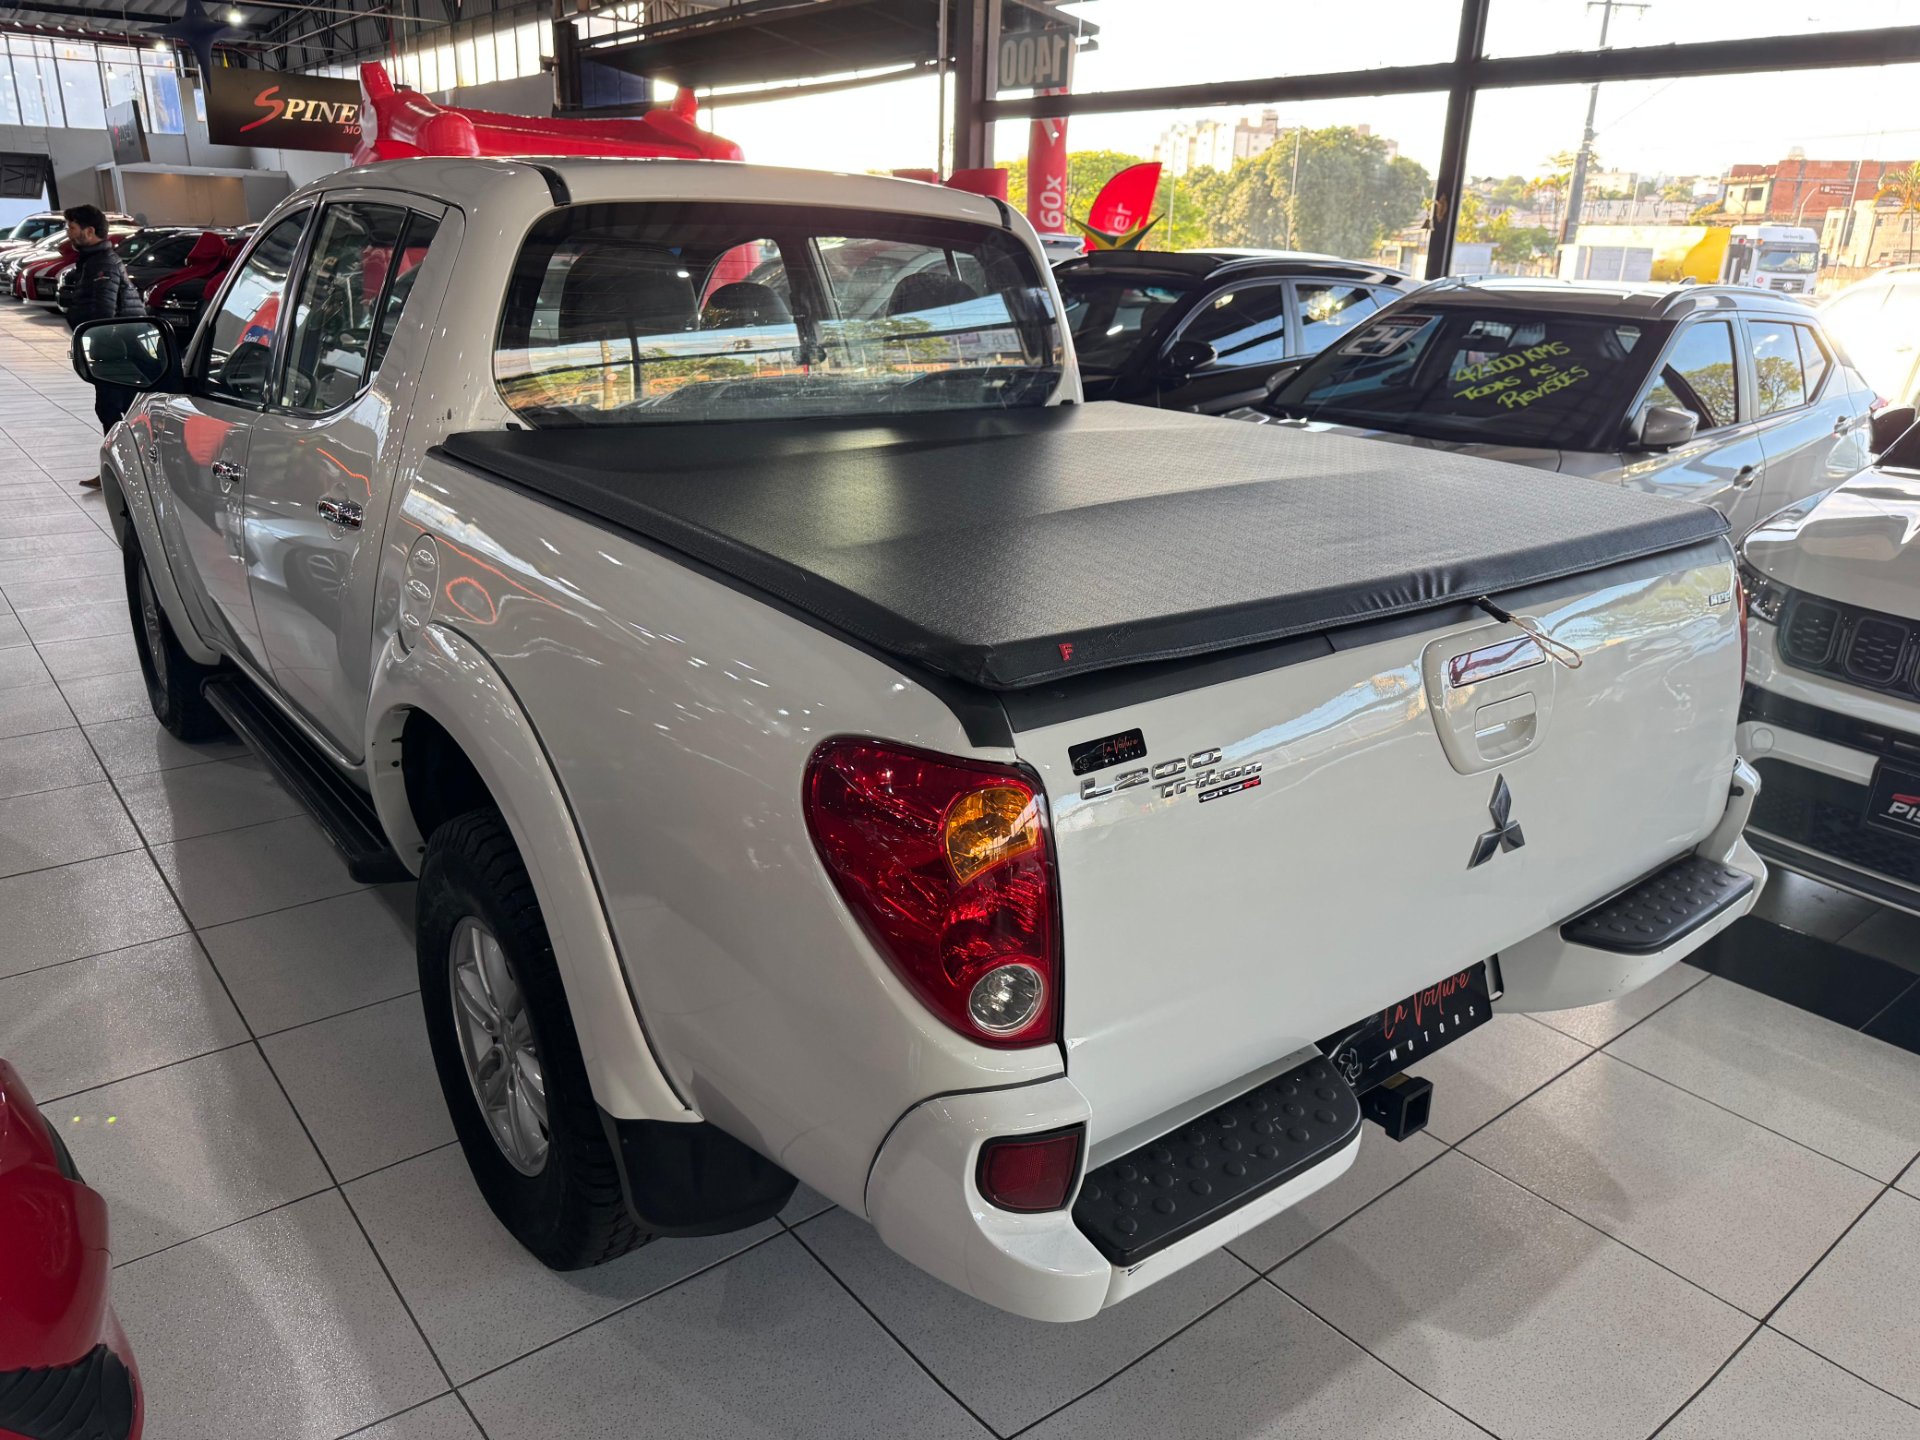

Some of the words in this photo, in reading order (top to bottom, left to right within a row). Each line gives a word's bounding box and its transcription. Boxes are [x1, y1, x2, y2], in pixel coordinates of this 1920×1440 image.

[240, 86, 361, 133] SPINE
[1040, 175, 1062, 228] 60x
[1344, 326, 1413, 354] 24
[1522, 341, 1571, 362] KMS
[1453, 376, 1522, 400] TODAS
[1529, 363, 1556, 377] AS
[1080, 747, 1223, 800] L200
[1152, 762, 1263, 799] Triton
[1389, 1005, 1475, 1062] MOTORS
